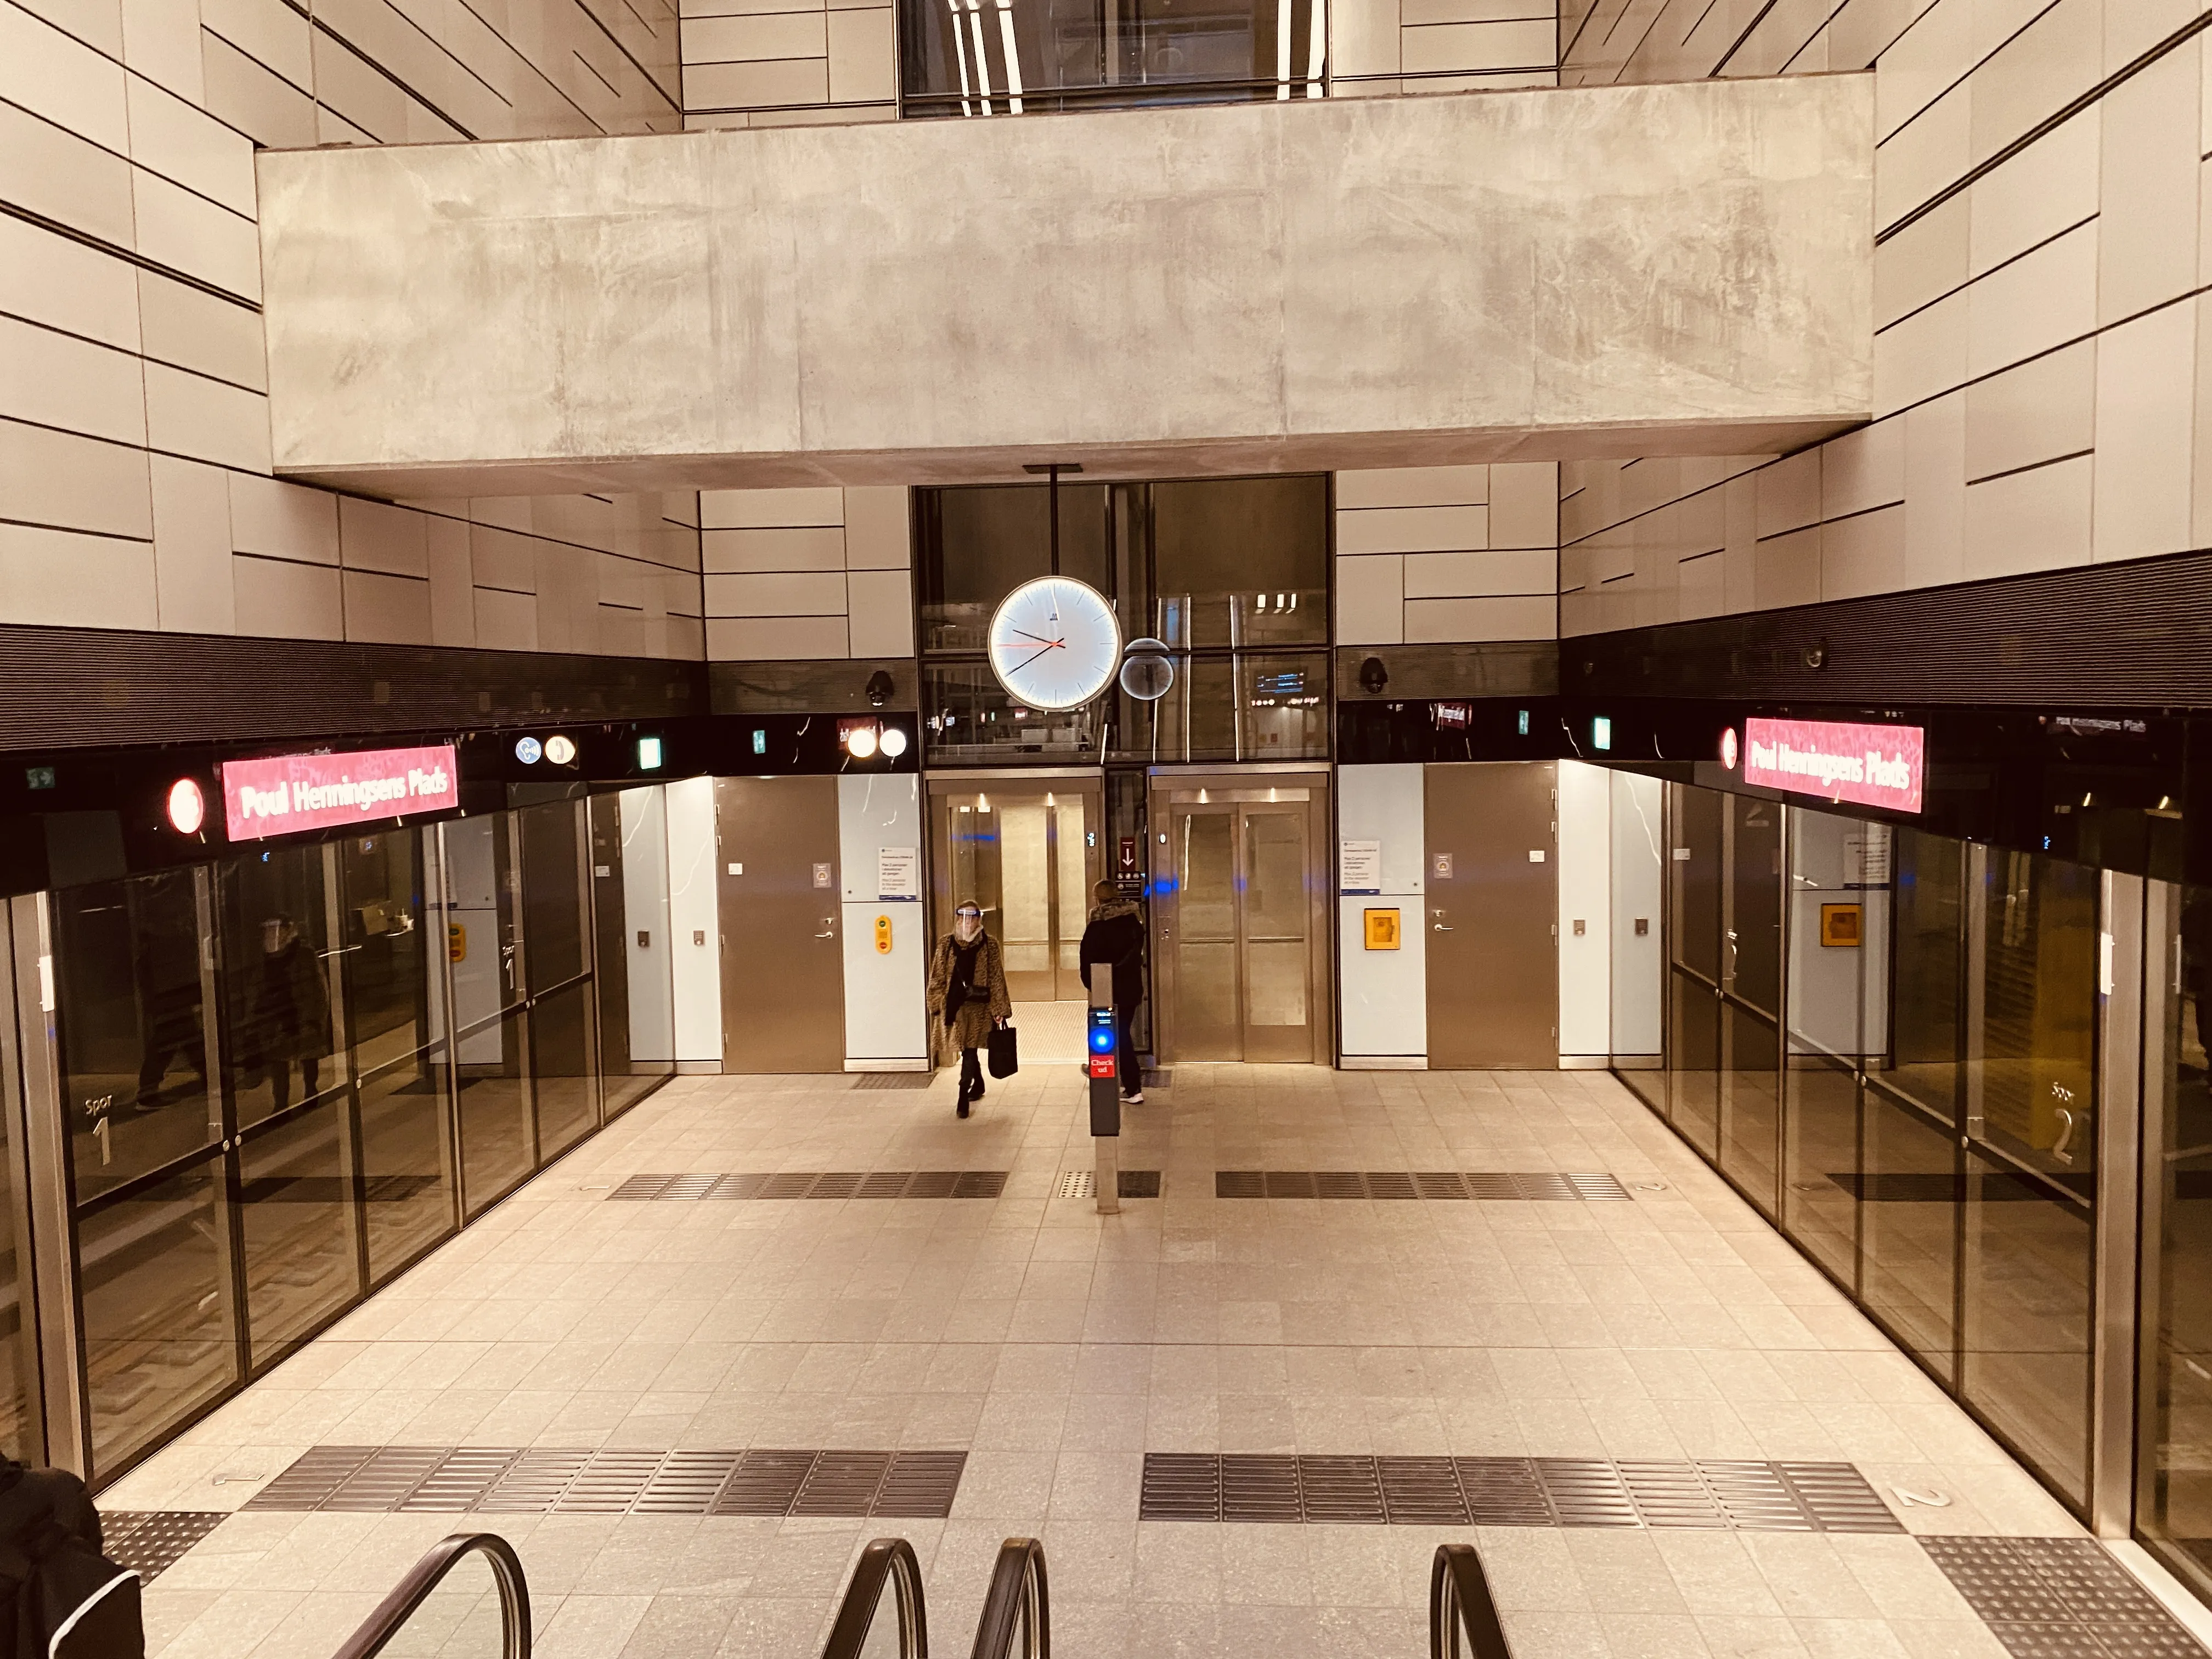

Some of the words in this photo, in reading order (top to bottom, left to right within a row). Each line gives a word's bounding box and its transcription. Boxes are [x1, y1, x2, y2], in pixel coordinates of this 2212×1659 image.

[1752, 741, 1776, 770] Poul
[1779, 743, 1863, 787] Henningsens
[1866, 750, 1910, 789] Plads
[241, 781, 289, 819] Poul
[293, 775, 406, 811] Henningsens
[408, 766, 448, 796] Plads
[86, 1095, 112, 1116] Spor
[93, 1116, 110, 1165] 1
[2054, 1109, 2073, 1165] 2
